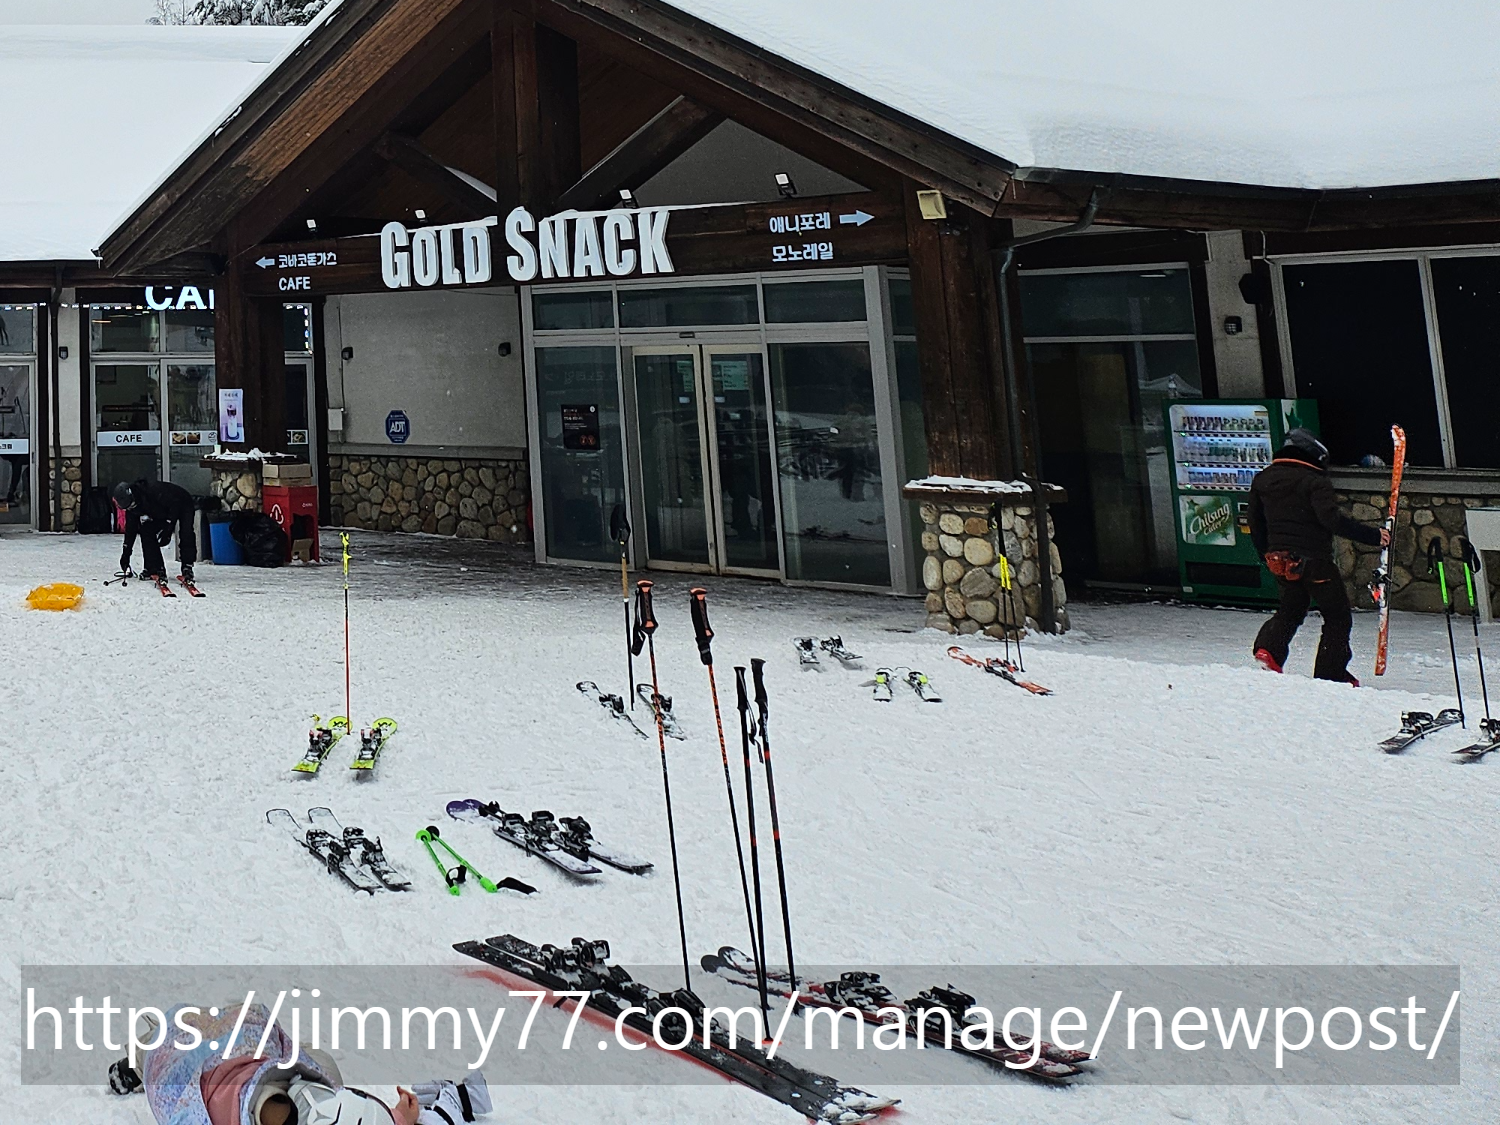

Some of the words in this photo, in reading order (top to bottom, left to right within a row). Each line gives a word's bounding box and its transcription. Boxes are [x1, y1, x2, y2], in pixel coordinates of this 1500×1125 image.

[769, 212, 831, 233] 애니포레
[380, 221, 492, 289] GOLD
[505, 206, 675, 282] SNACK
[772, 242, 834, 262] 모노레일
[278, 276, 311, 291] CAFE
[389, 421, 406, 433] ADT
[115, 434, 143, 443] CAFE
